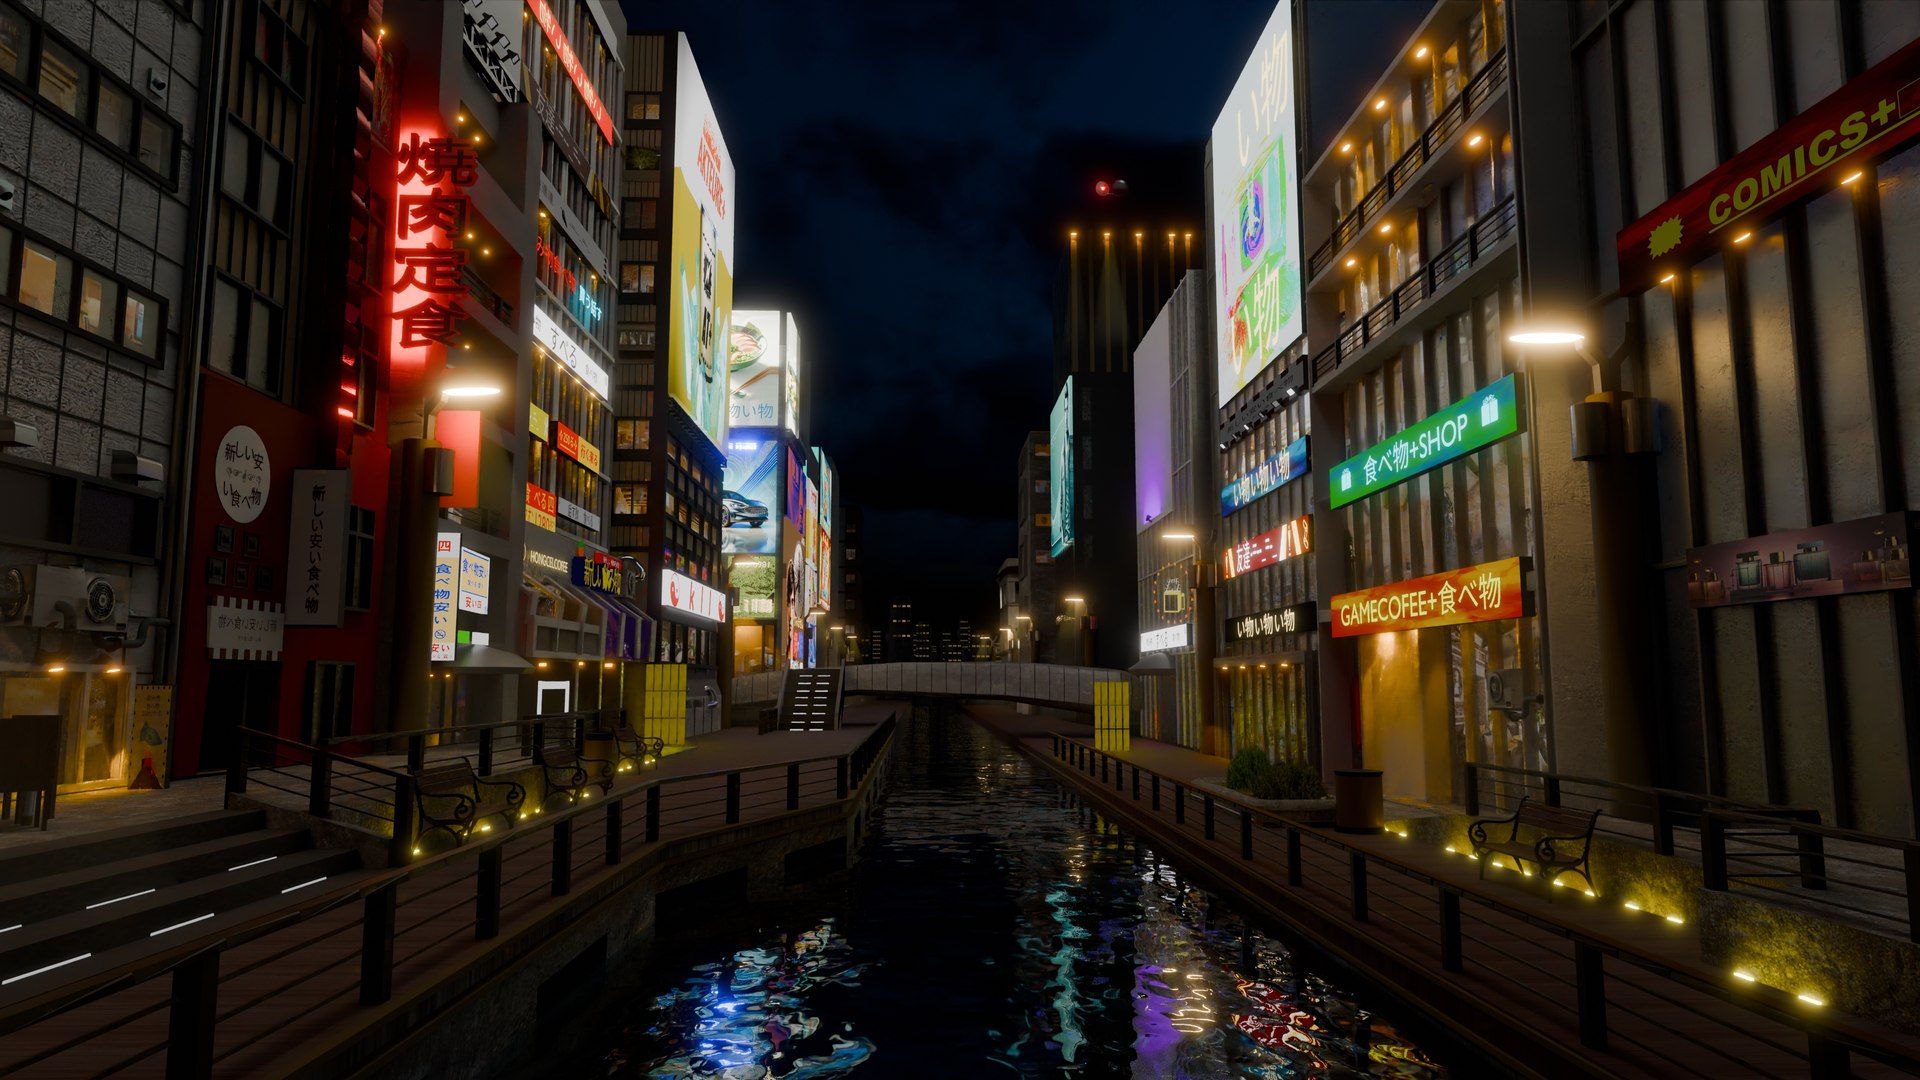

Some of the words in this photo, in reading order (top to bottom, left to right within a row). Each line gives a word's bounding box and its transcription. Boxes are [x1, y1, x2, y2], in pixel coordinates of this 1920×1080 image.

[1708, 98, 1896, 225] COMICS+
[391, 132, 478, 349] 焼肉定食
[224, 440, 264, 472] 新しい安
[1233, 447, 1290, 507] い物い物い物
[1363, 413, 1468, 486] 食べ物+SHOP
[222, 480, 262, 509] い食べ物
[304, 485, 326, 614] 新しい安い食べ物
[438, 541, 451, 552] 四
[433, 563, 452, 624] 食べ物安い
[1236, 609, 1296, 638] い物い物い物
[1340, 572, 1501, 627] GAMECOFEE+食べ物
